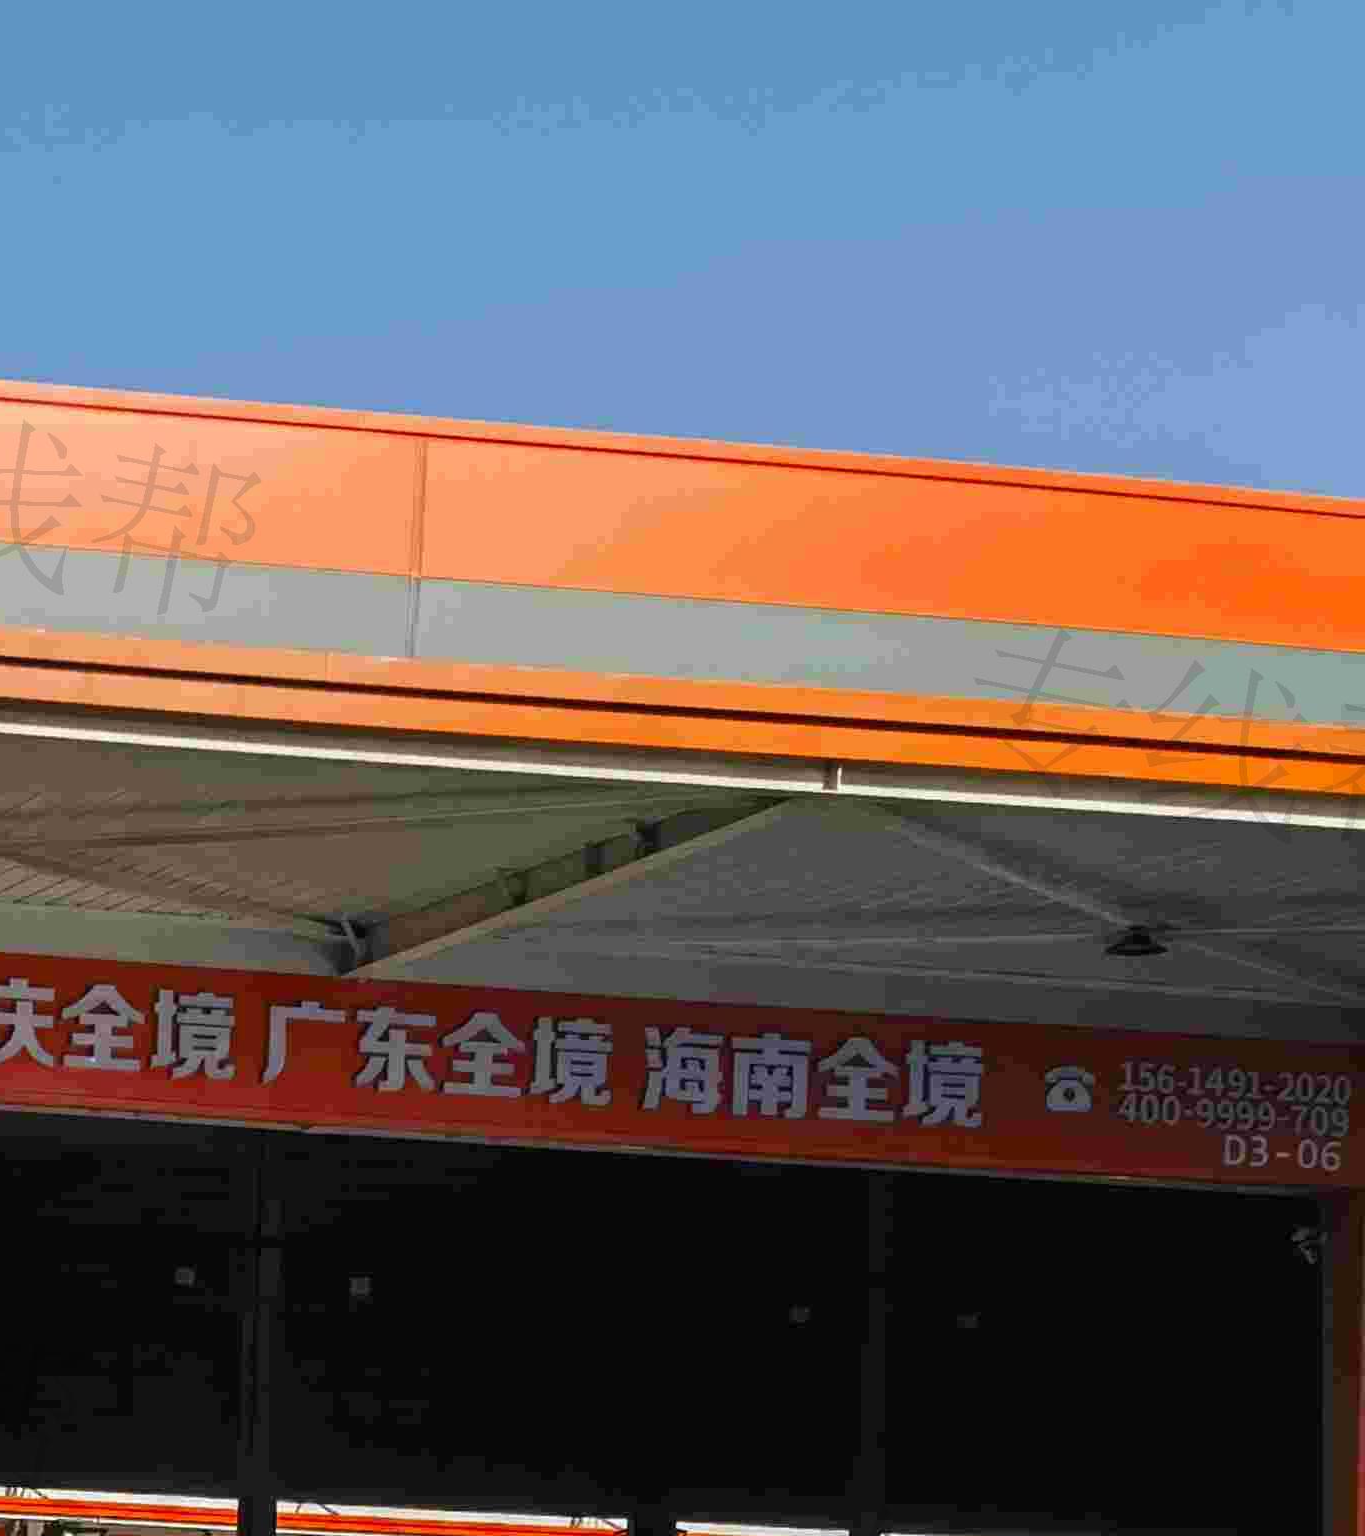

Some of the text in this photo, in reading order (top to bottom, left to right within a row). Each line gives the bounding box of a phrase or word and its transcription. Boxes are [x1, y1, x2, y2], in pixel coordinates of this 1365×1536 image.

[262, 999, 613, 1108] 广东全境
[643, 1023, 985, 1129] 海南全境
[1119, 1061, 1353, 1108] 156-1491-2020
[1118, 1093, 1351, 1138] 400-9999-709
[1223, 1133, 1342, 1172] D3-06
